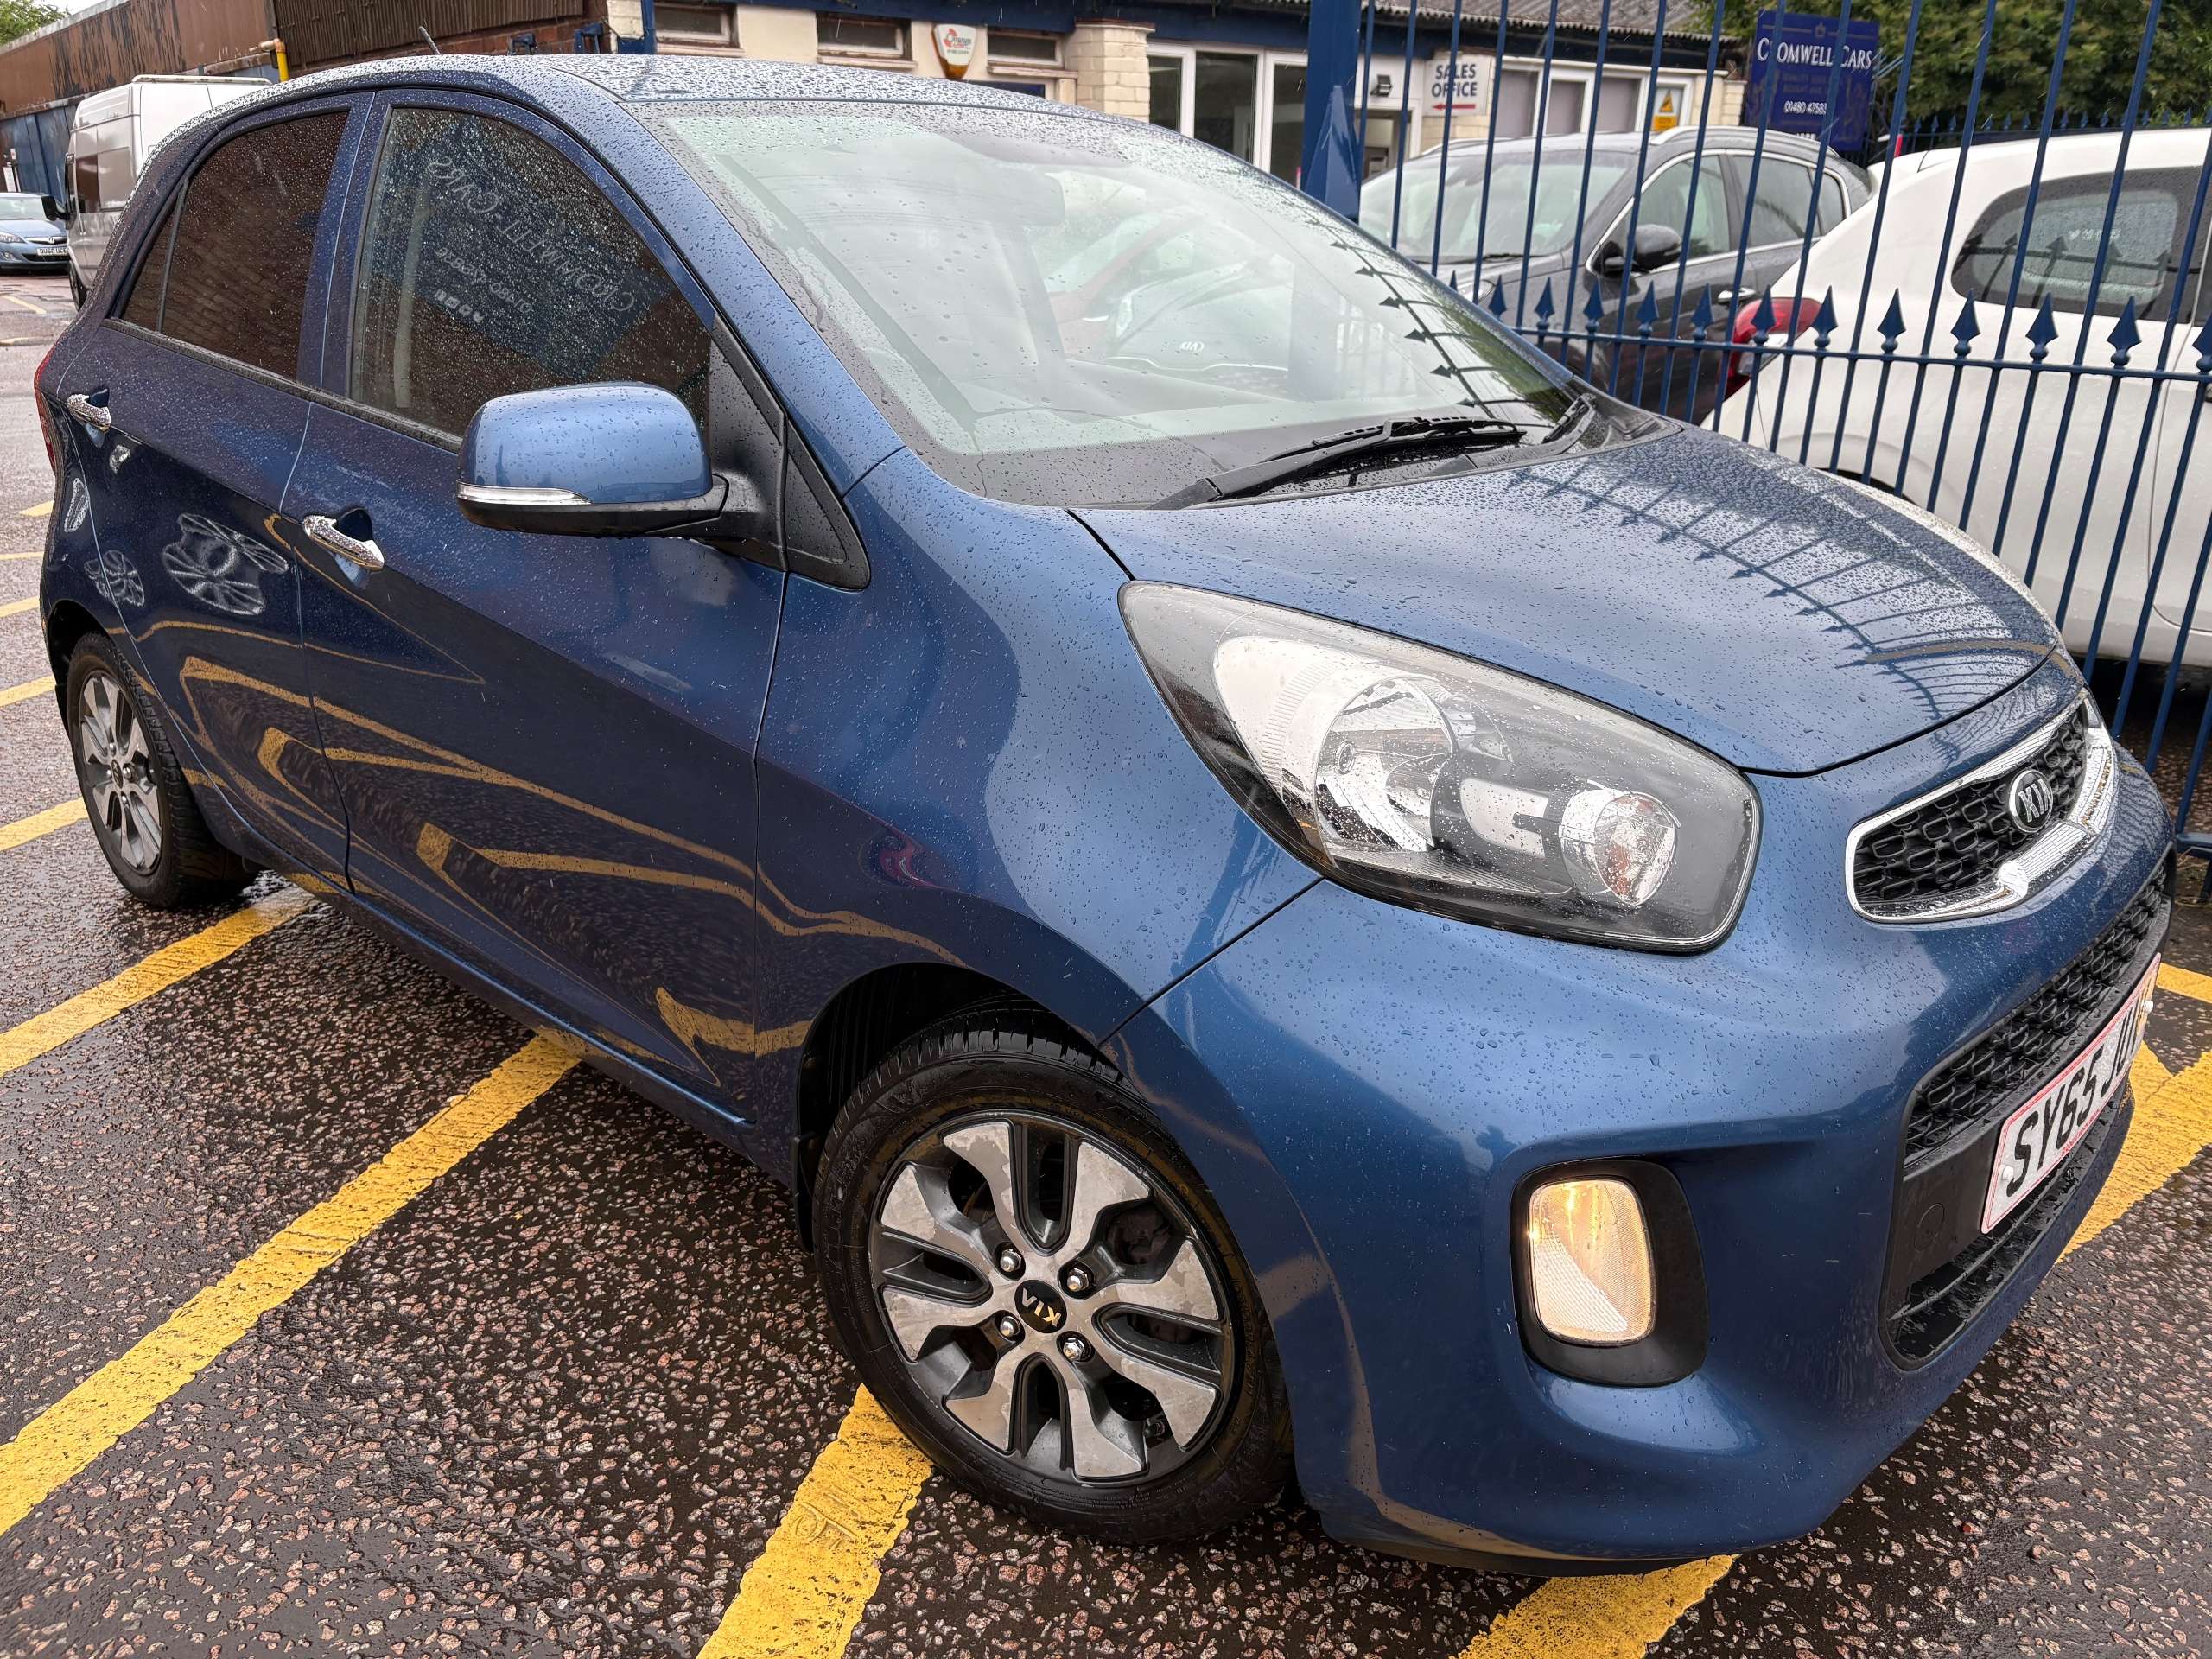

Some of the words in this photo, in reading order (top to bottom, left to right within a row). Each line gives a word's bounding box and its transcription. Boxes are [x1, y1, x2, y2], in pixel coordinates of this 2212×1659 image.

[1757, 37, 1833, 67] COMWELL
[2018, 778, 2051, 823] KIA
[2006, 1044, 2104, 1197] SY65
[1021, 1287, 1062, 1327] KIA
